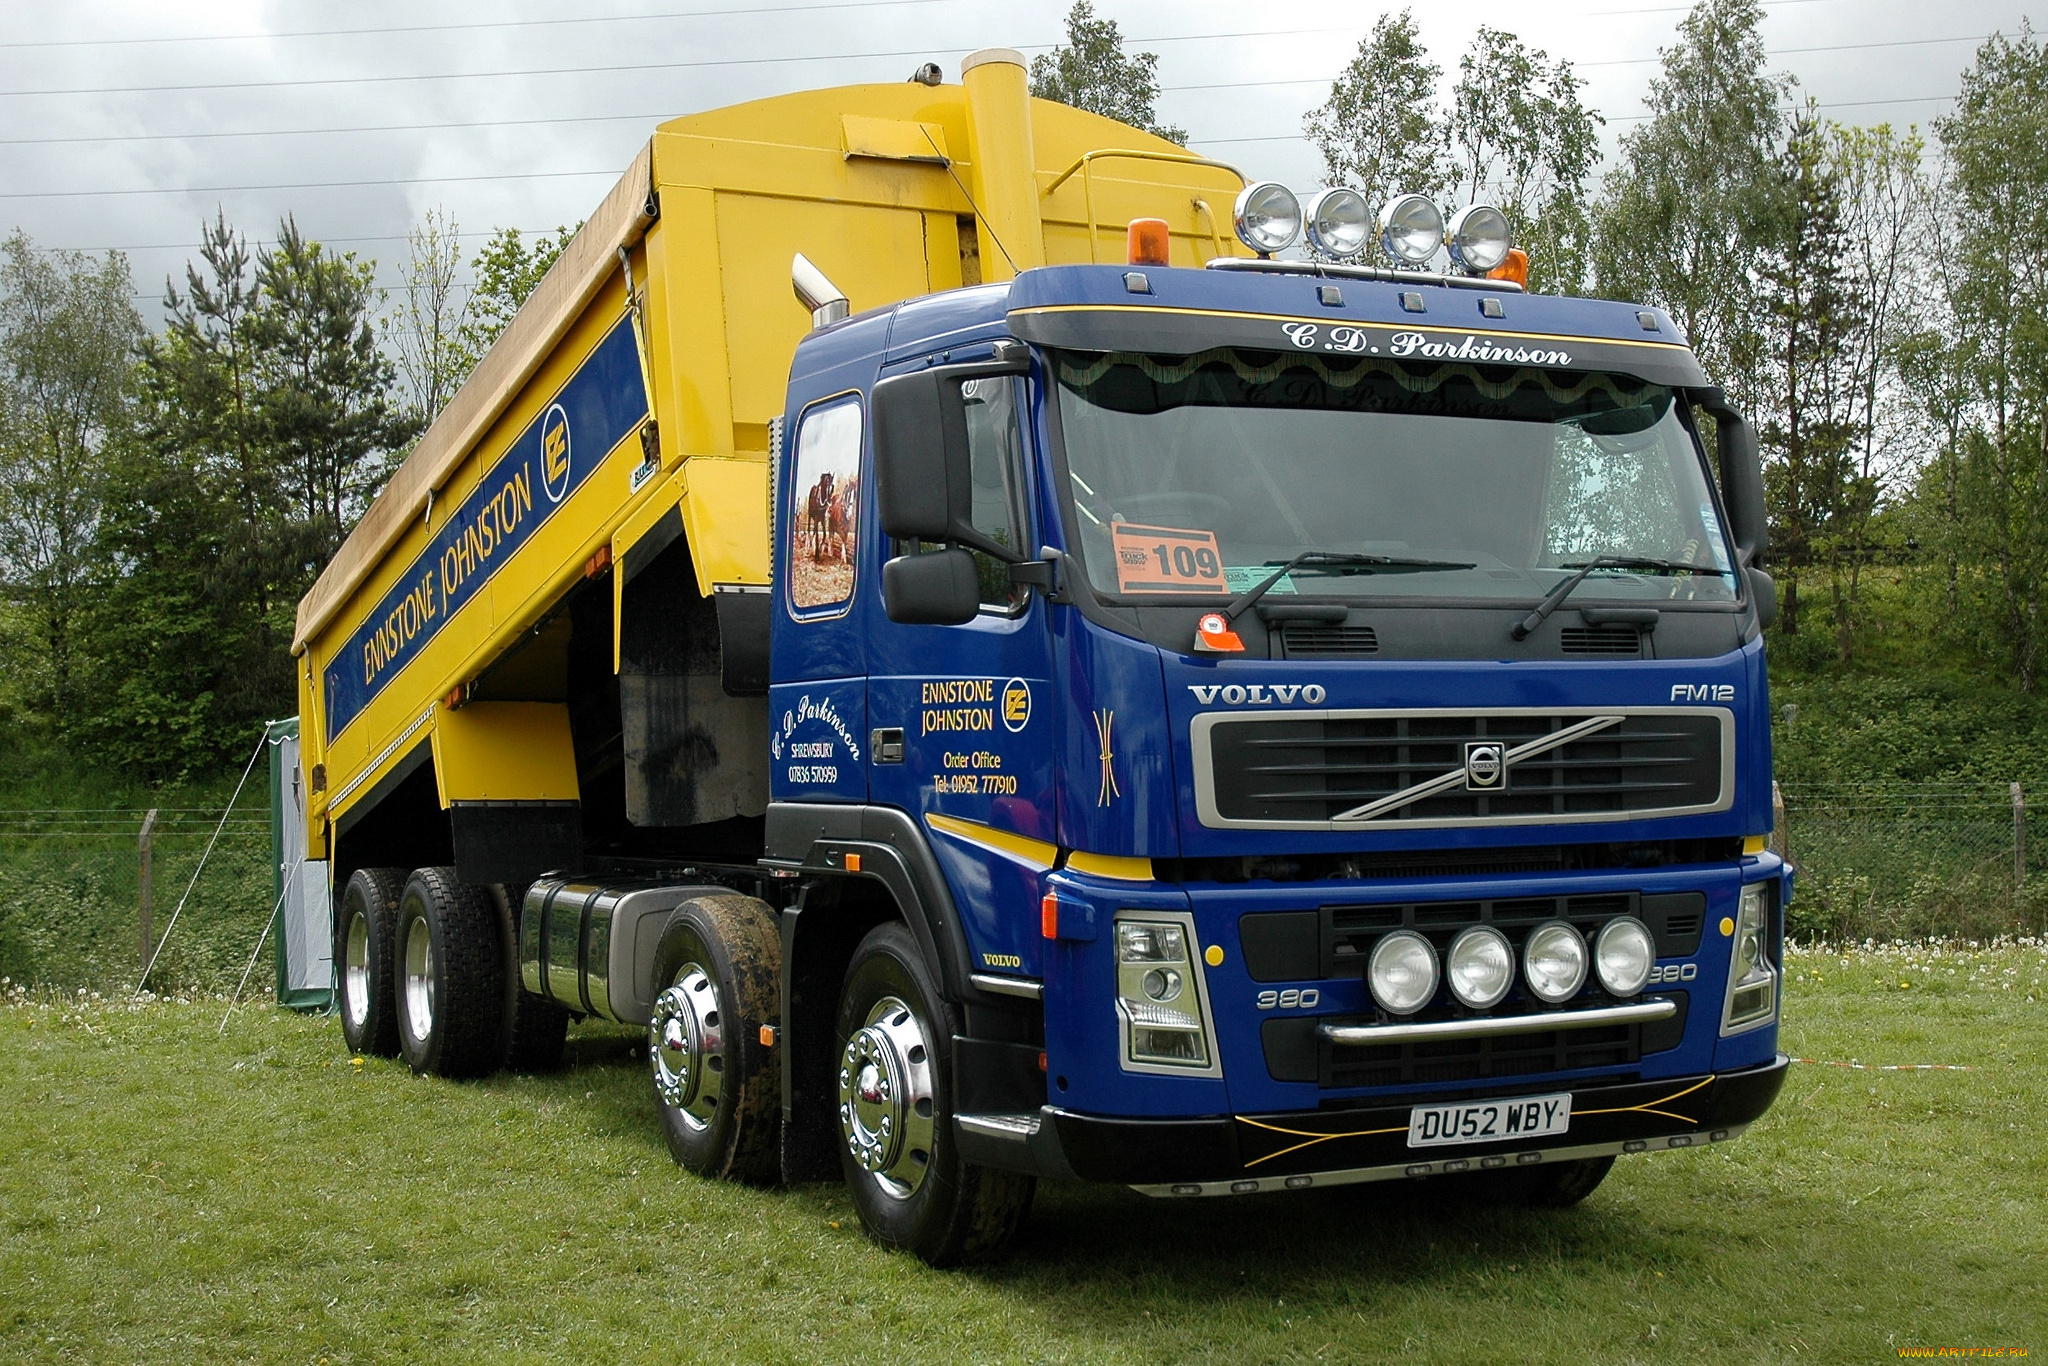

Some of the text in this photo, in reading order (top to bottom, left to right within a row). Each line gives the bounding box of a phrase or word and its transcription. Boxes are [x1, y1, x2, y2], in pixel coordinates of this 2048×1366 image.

[1390, 331, 1572, 366] Parkinson
[1153, 544, 1220, 578] 109
[364, 461, 532, 685] ENNSTONE JOHNSTON
[922, 680, 994, 704] ENNSTONE
[1187, 684, 1326, 705] VOLVO
[798, 694, 860, 761] Parkinson
[921, 708, 993, 737] JOHNSTON
[791, 742, 834, 758] SHREWSBURY
[943, 751, 1001, 769] Order Office
[788, 766, 810, 783] 07836
[951, 774, 978, 793] 01952
[981, 775, 1017, 795] 777910
[982, 953, 1020, 968] VOLVO
[1256, 989, 1320, 1010] 380
[1421, 1100, 1560, 1141] DU52 WBY
